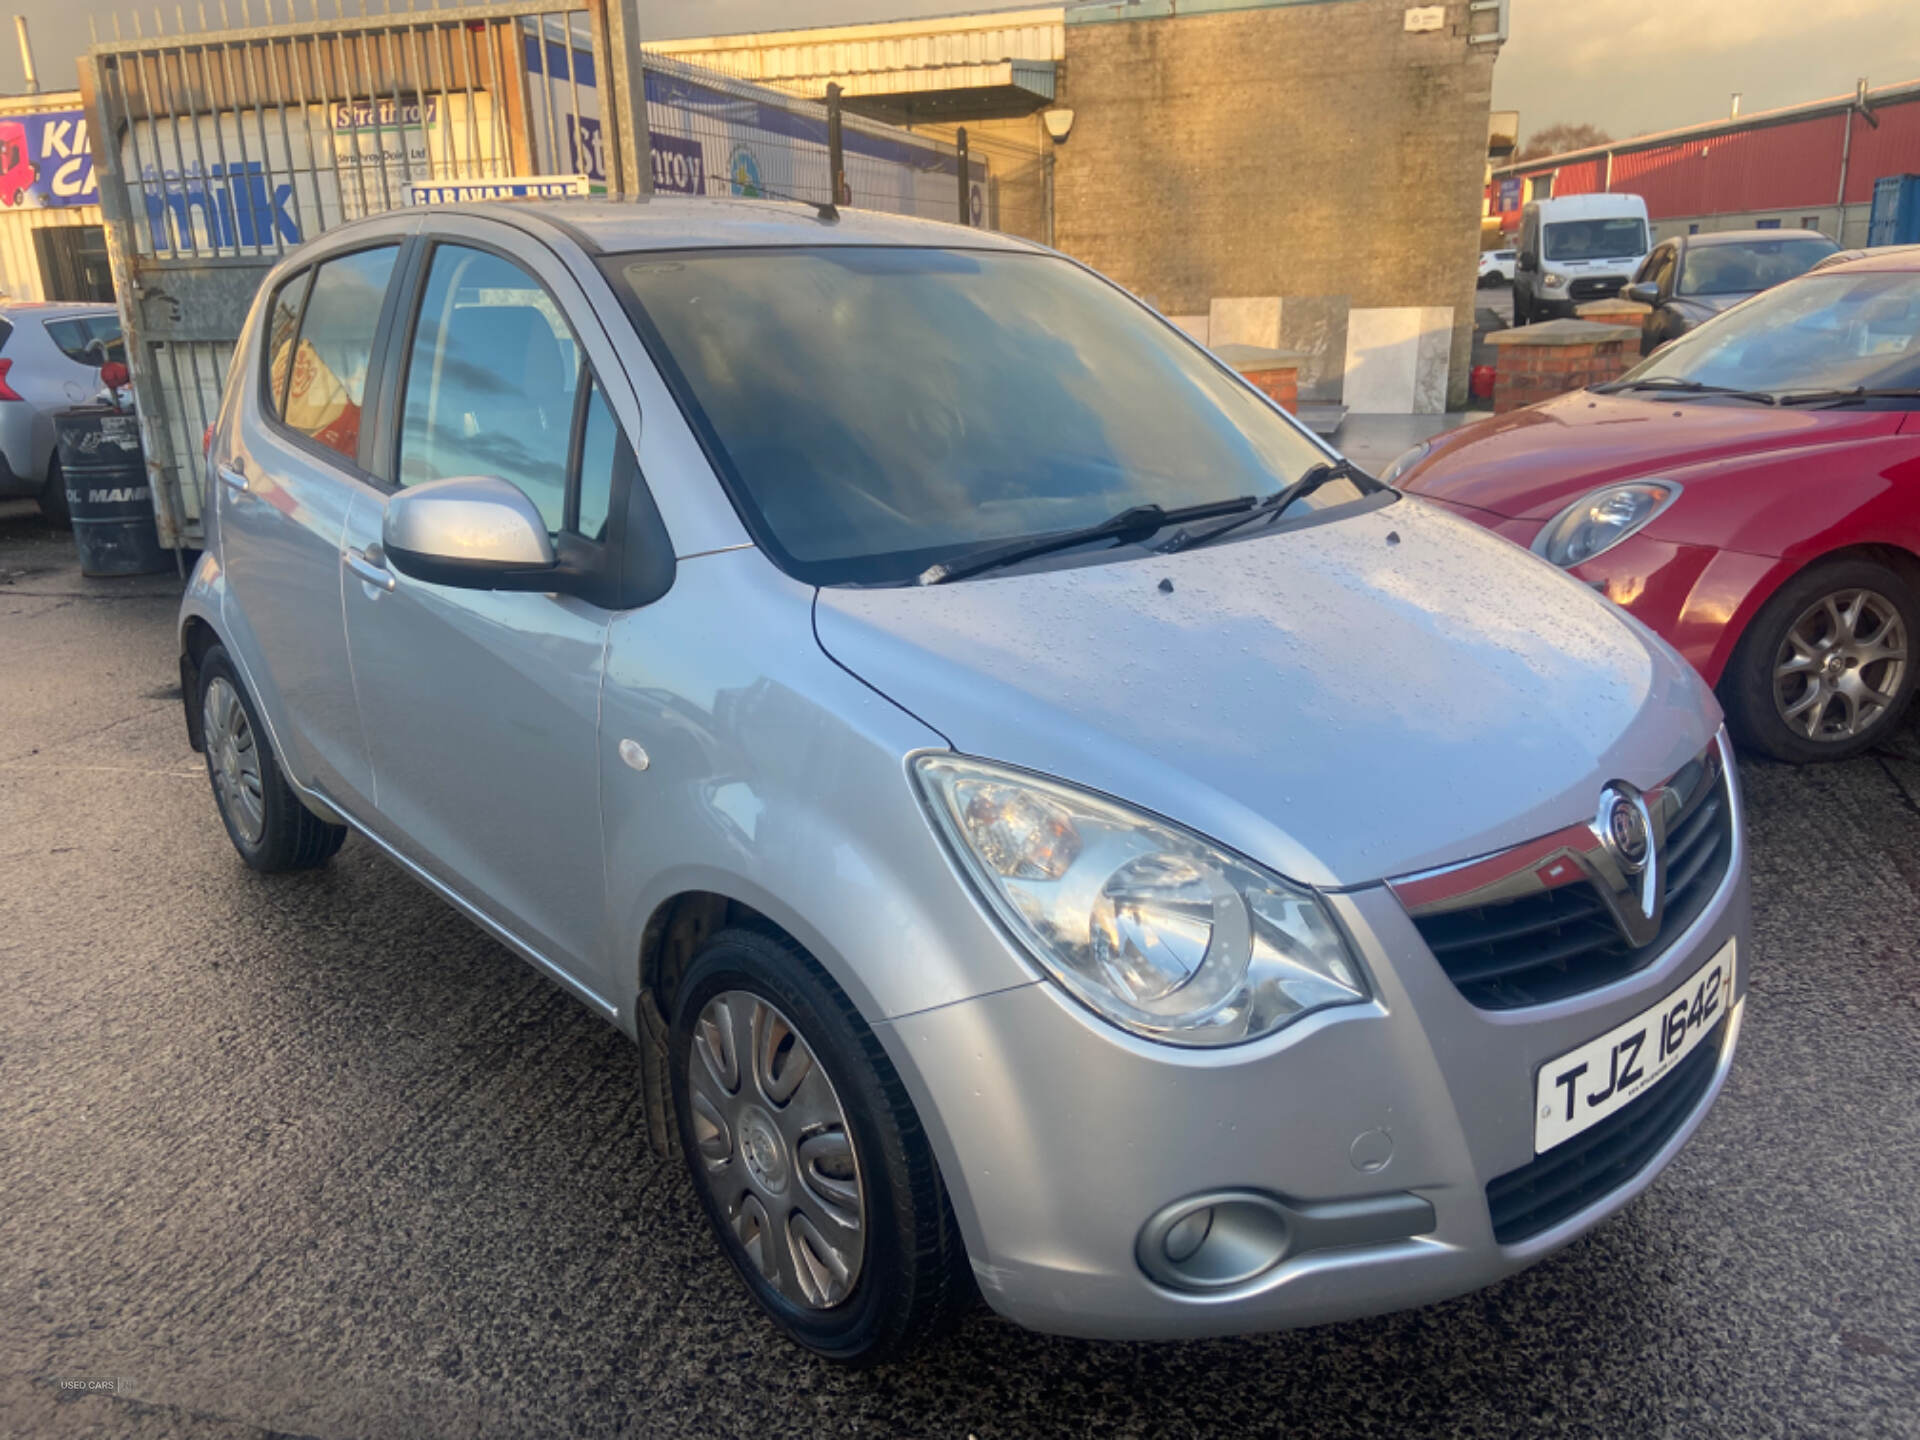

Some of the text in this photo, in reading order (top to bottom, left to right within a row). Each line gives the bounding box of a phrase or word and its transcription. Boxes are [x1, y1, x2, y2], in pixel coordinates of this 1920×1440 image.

[145, 161, 302, 250] milk
[1556, 1028, 1646, 1122] TJZ
[1659, 965, 1721, 1063] 1642
